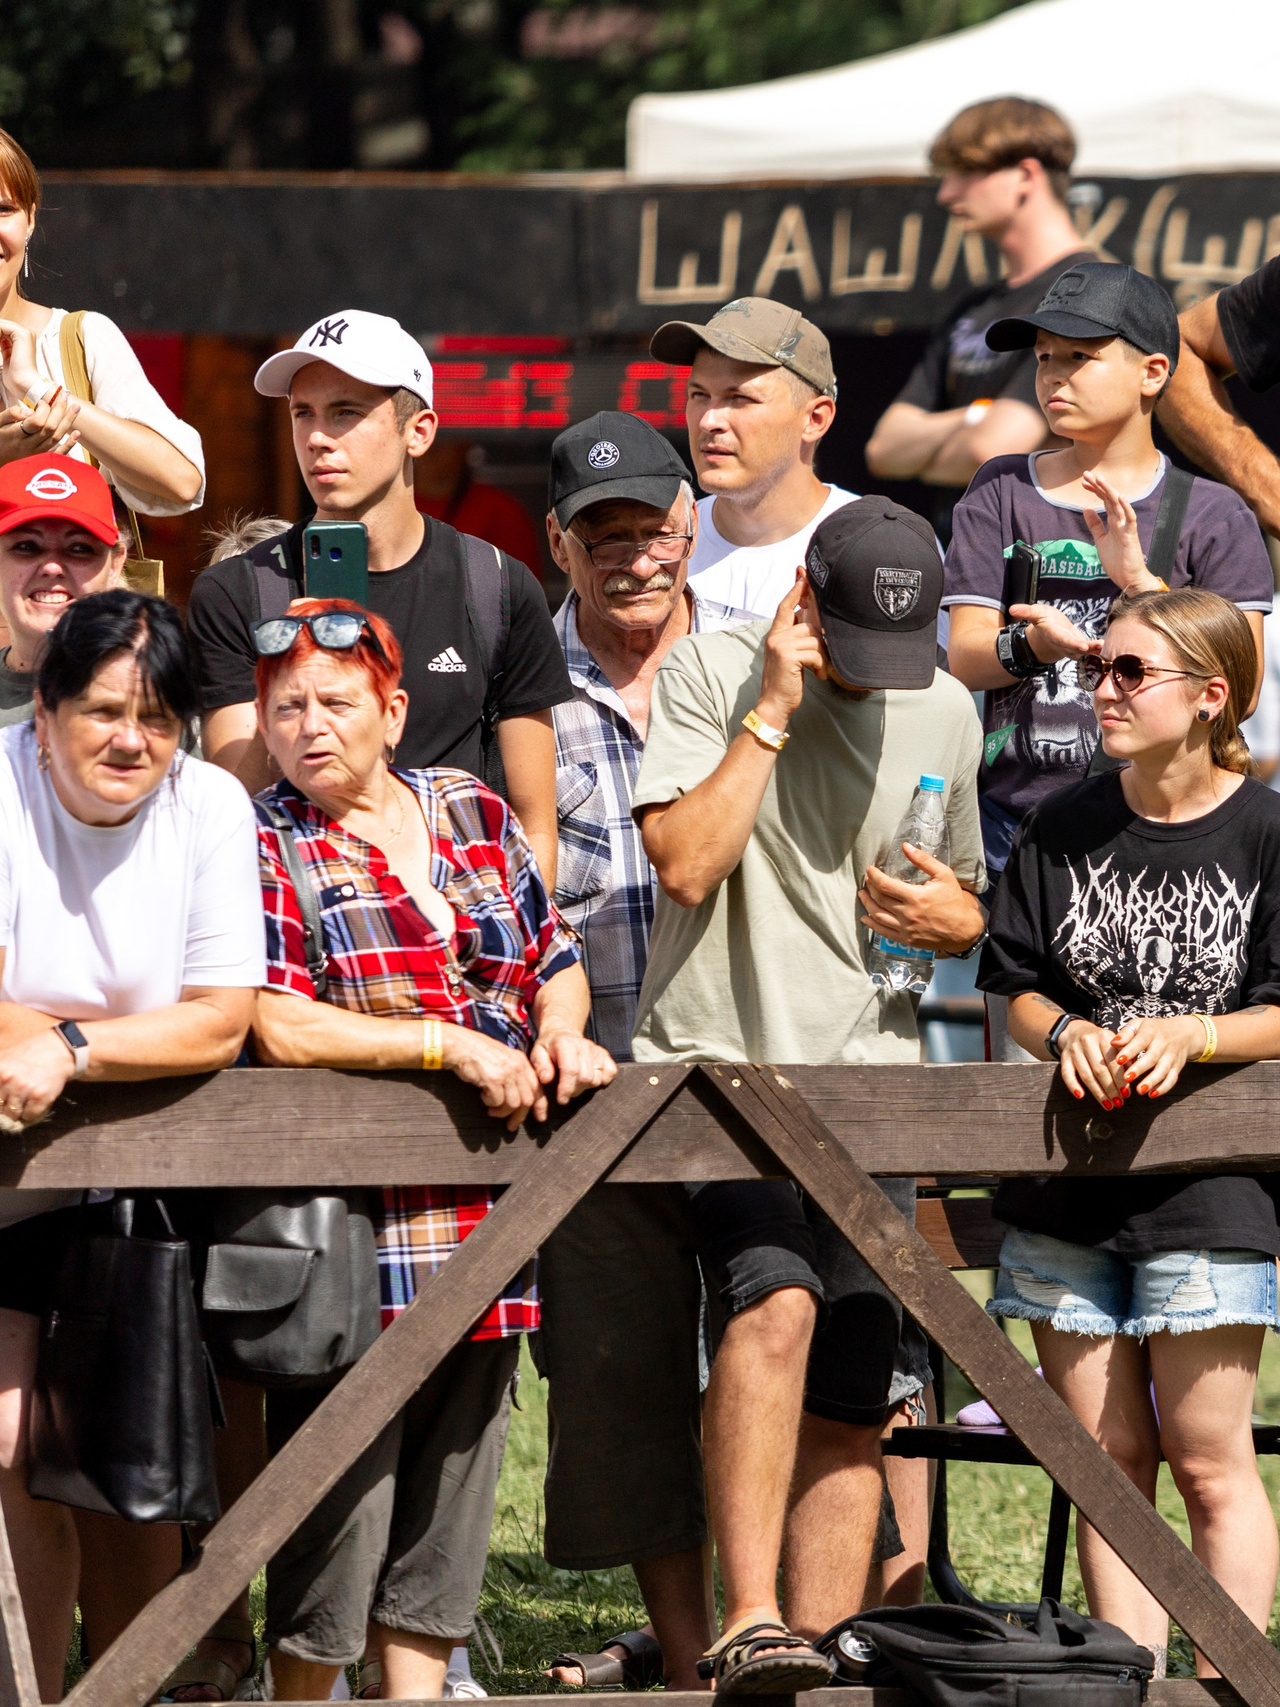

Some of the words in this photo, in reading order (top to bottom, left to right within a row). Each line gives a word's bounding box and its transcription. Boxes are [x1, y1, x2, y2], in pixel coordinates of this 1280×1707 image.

[638, 197, 1129, 305] ШАШЛК
[309, 318, 350, 348] NY
[427, 661, 468, 673] adidas
[1088, 954, 1114, 983] ortrait
[1204, 993, 1217, 1016] thin
